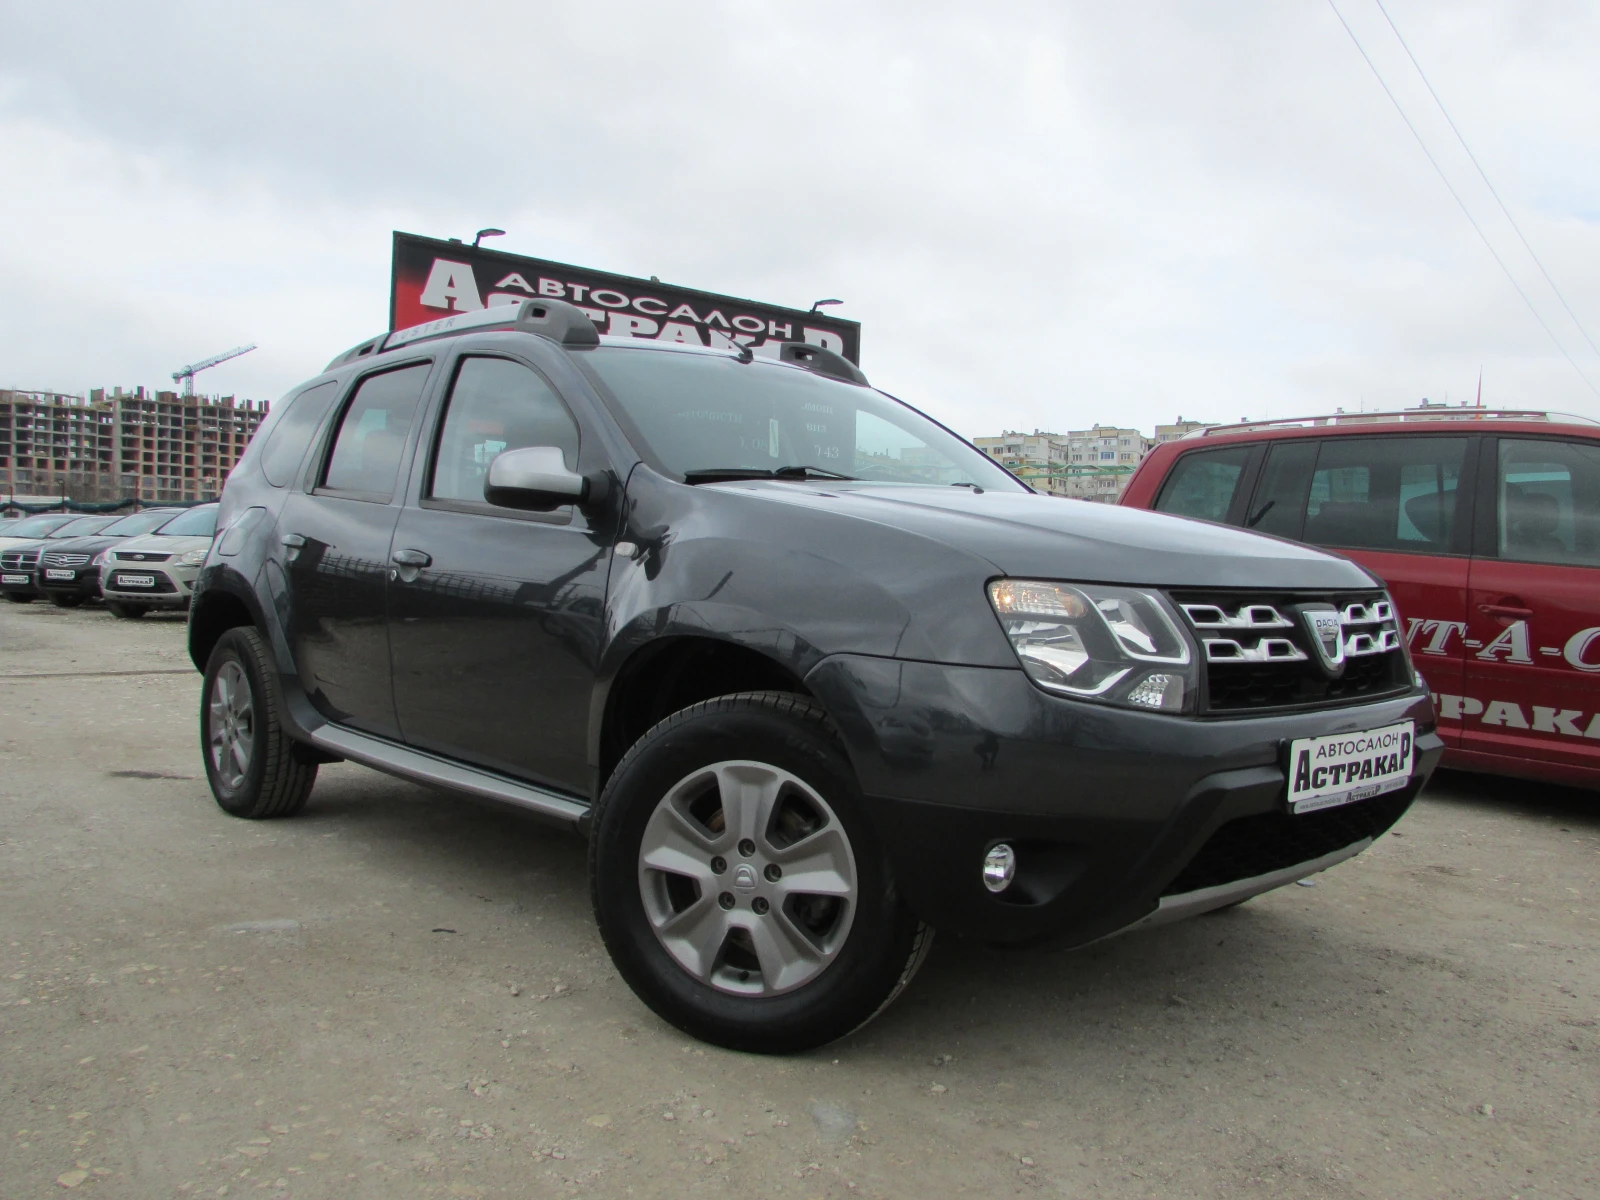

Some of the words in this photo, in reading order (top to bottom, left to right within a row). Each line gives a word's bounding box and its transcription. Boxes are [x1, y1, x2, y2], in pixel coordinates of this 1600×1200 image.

[495, 272, 791, 338] АВТОСАЛОН
[390, 317, 456, 343] DUSTER
[1316, 619, 1339, 628] DACIA
[1316, 732, 1399, 759] АВТОСАЛОН
[1294, 731, 1411, 793] АСТРАКАР
